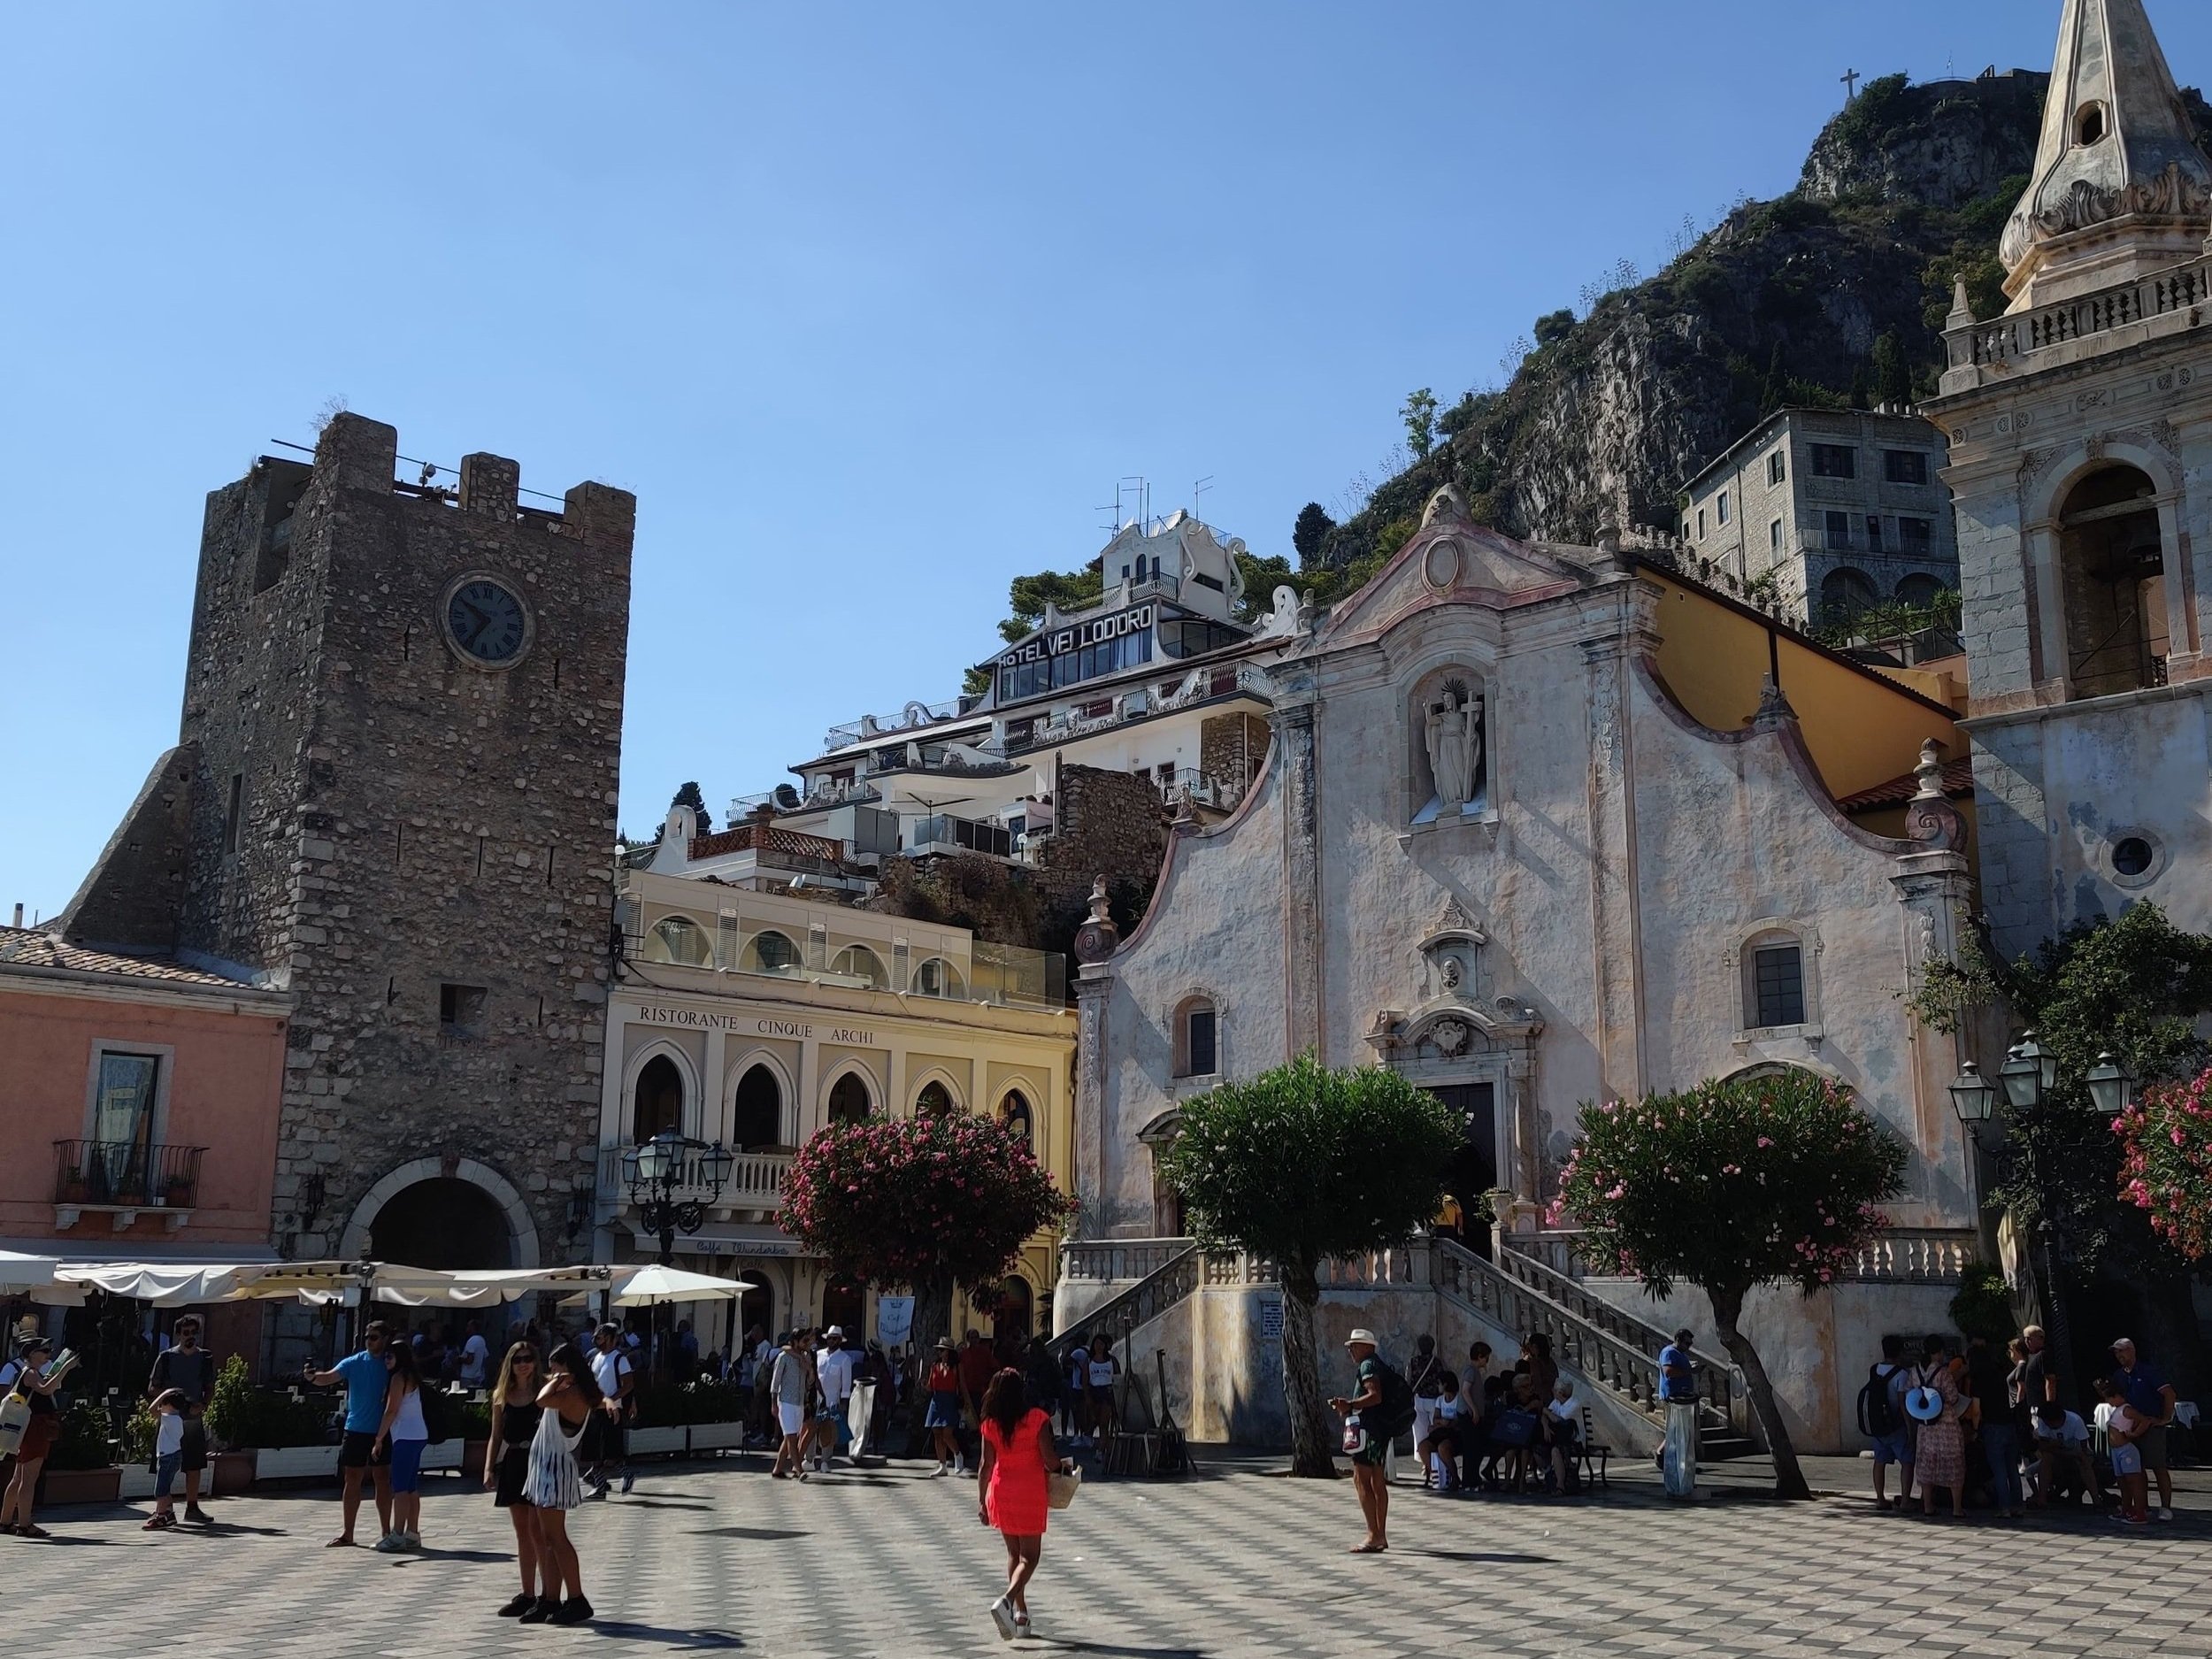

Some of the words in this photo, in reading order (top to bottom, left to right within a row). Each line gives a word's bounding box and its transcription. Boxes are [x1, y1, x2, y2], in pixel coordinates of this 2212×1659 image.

[999, 641, 1048, 668] HOTEL
[641, 1006, 738, 1030] RISTORANTE
[757, 1019, 813, 1038] CINQUE
[831, 1028, 874, 1044] ARCHI
